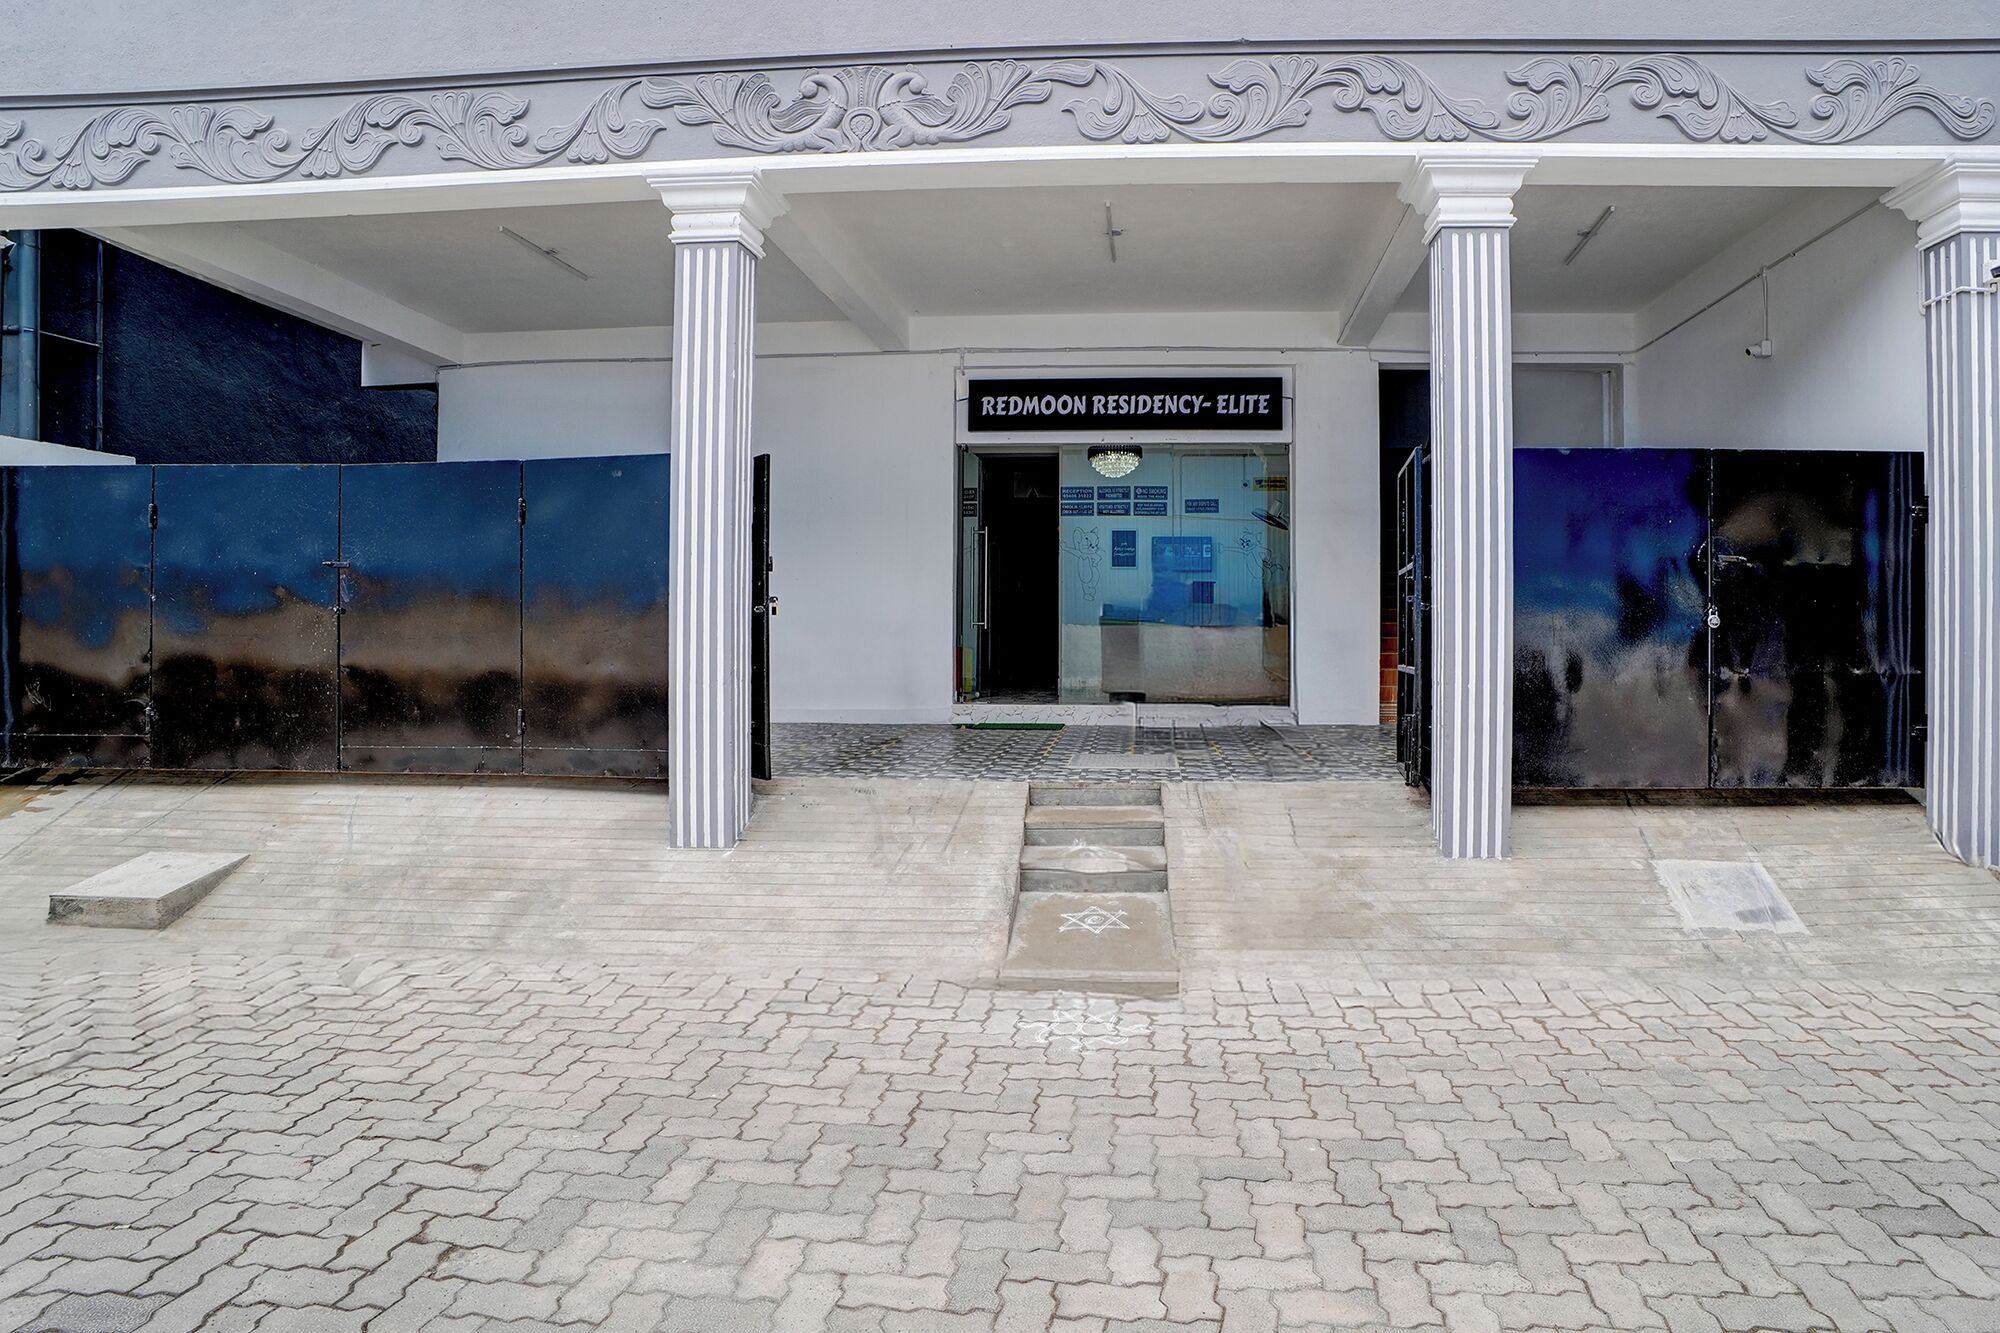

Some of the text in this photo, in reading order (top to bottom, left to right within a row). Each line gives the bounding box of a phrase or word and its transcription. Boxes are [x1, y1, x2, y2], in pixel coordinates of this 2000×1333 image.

[981, 394, 1270, 415] REDMOON RESIDENCY- ELITE
